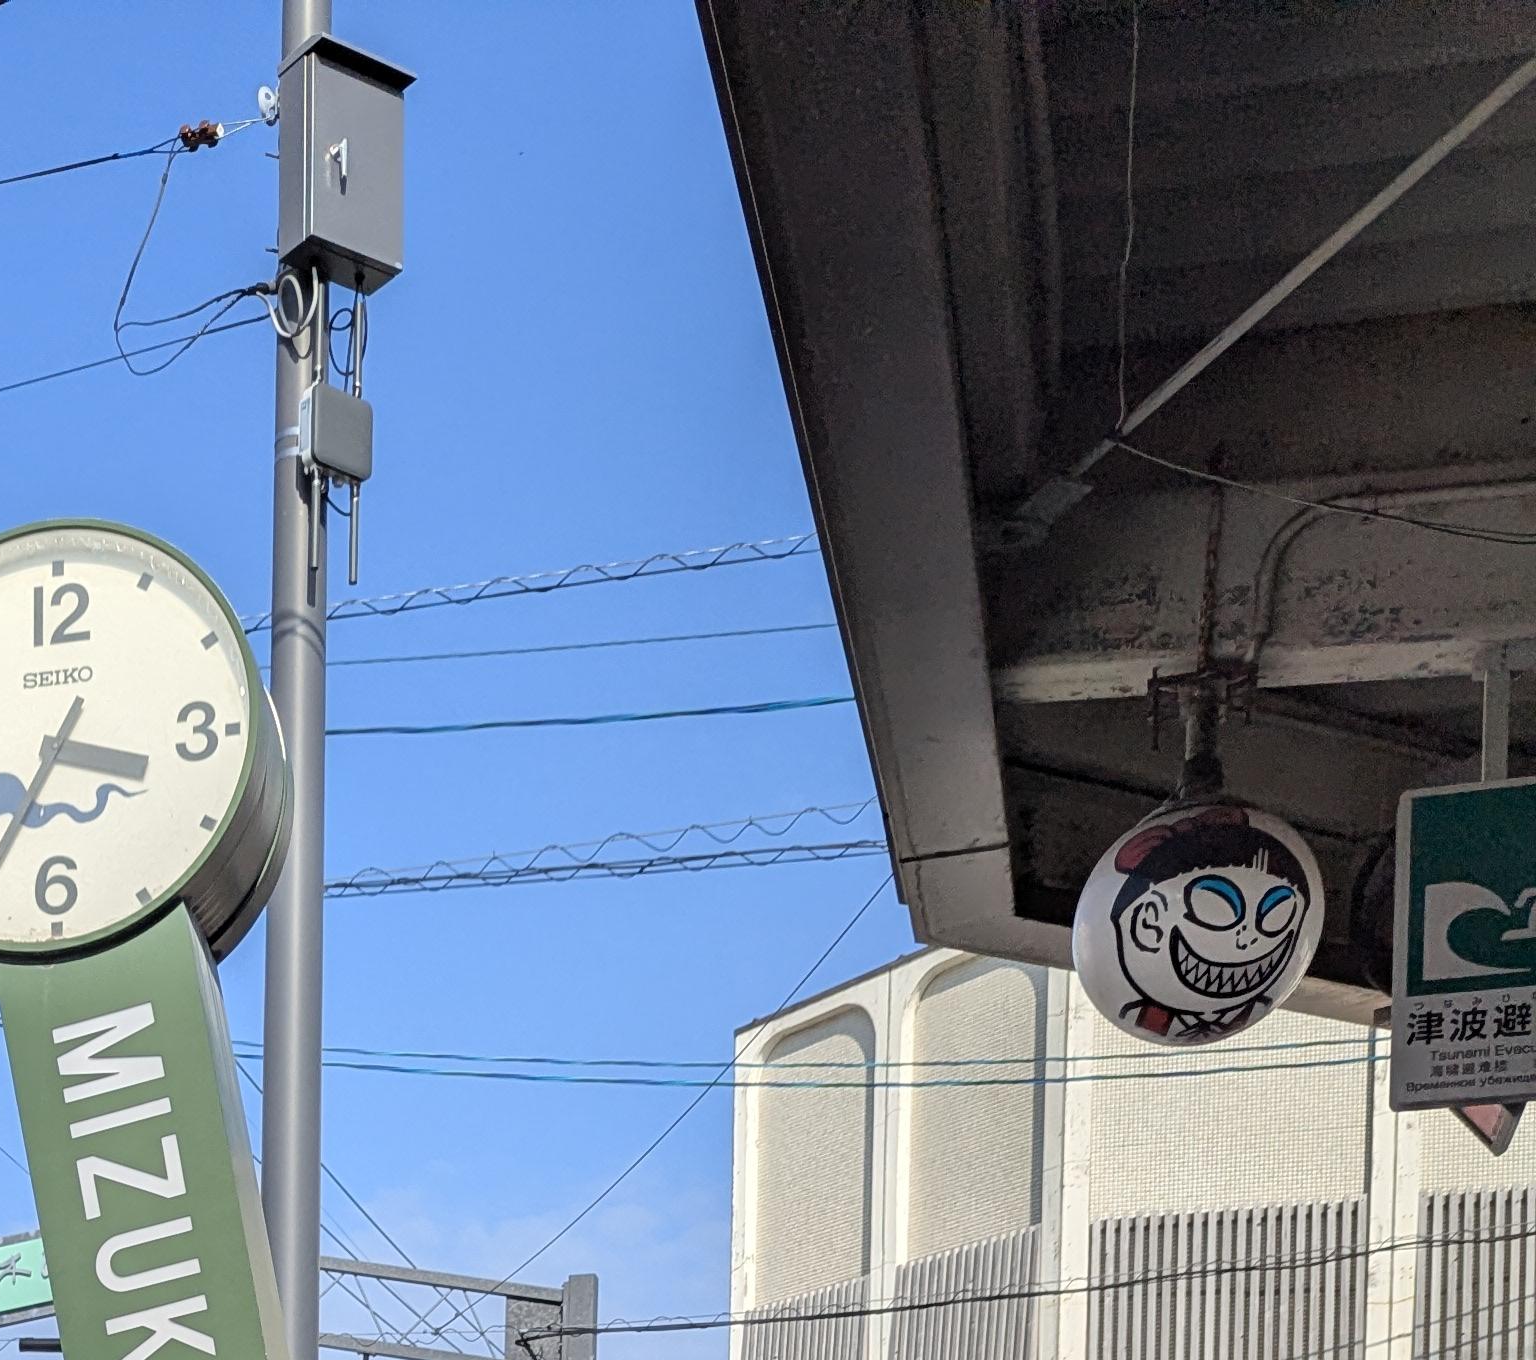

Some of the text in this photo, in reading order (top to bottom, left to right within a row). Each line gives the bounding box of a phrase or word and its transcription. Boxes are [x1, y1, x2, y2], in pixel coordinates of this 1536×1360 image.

[33, 583, 91, 647] 12
[23, 666, 94, 690] SEIKO
[175, 701, 219, 762] 3
[34, 855, 78, 916] 6
[1407, 1003, 1532, 1046] 津波避
[1430, 1047, 1490, 1061] Tsunami
